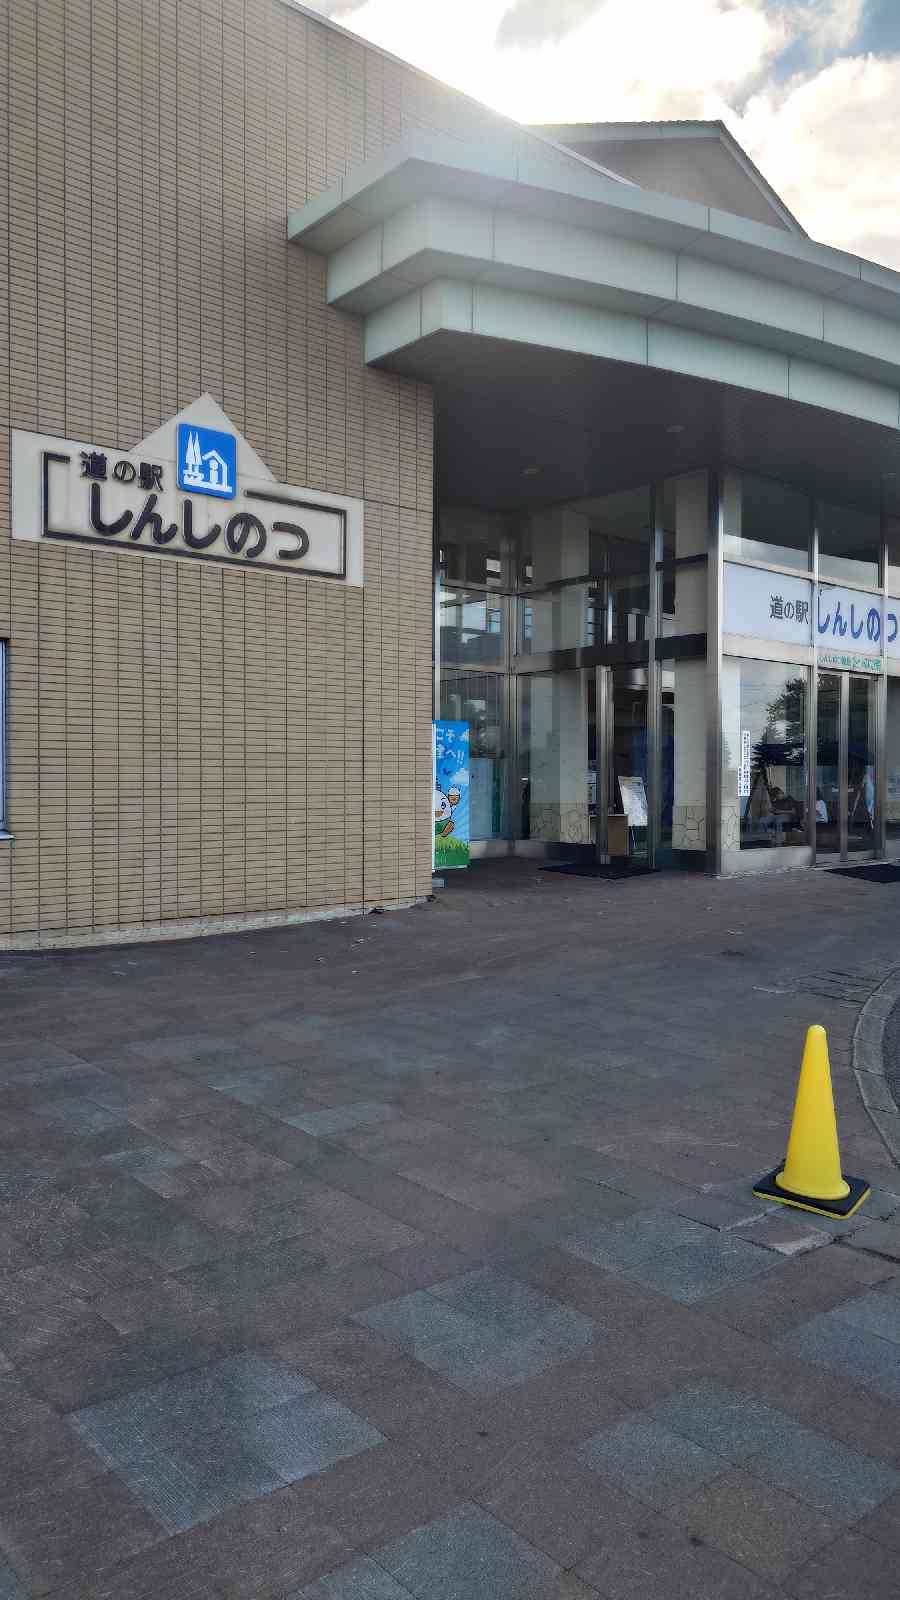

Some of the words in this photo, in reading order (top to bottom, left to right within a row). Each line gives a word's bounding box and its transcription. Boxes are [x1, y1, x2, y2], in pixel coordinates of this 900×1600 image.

[79, 450, 164, 492] 道の駅
[90, 482, 310, 559] しんしのつ
[769, 593, 809, 625] 道の駅
[817, 595, 898, 643] しんしのつ
